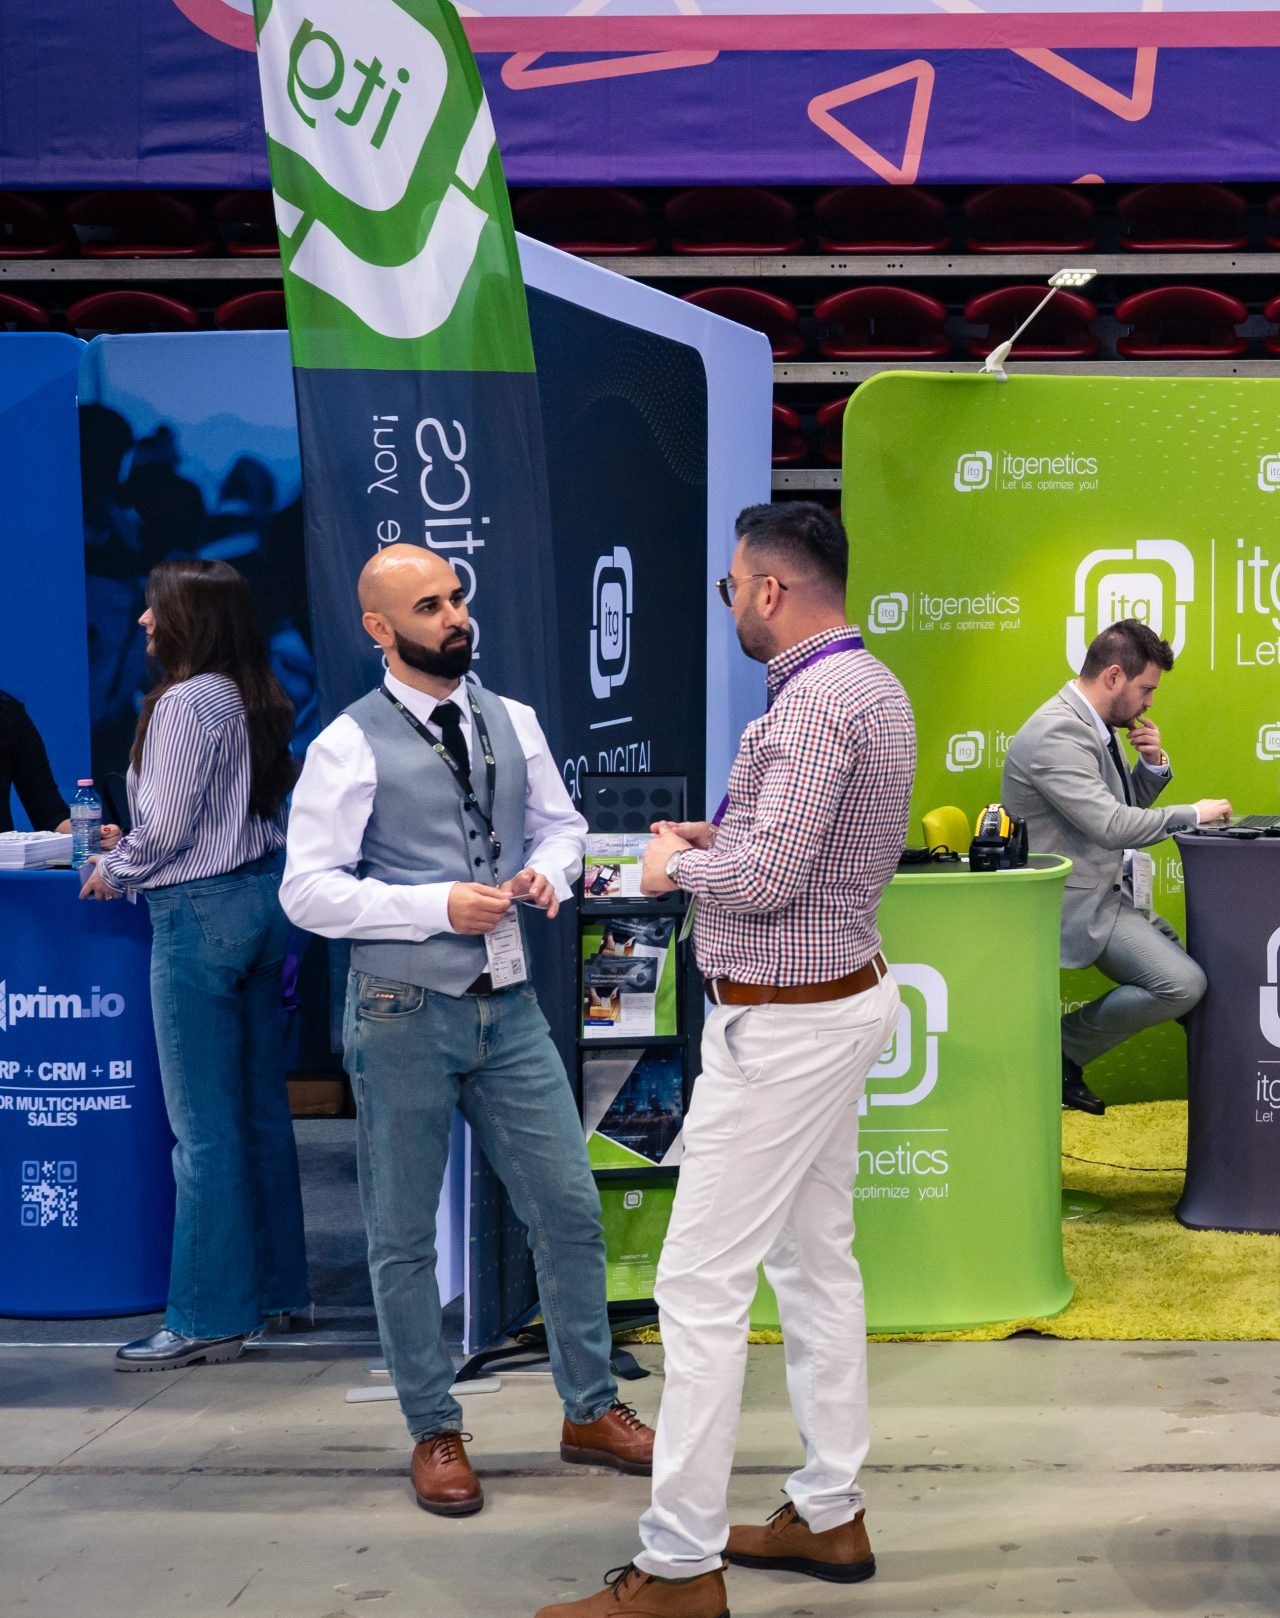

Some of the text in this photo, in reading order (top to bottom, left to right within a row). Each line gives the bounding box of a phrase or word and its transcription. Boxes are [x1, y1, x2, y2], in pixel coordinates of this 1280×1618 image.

[967, 466, 980, 478] itg
[1003, 451, 1098, 479] itgenetics
[1002, 480, 1017, 489] Let
[1037, 480, 1074, 491] optimize
[1079, 479, 1099, 491] you!
[881, 607, 895, 619] itg
[919, 591, 1020, 621] itgenetics
[604, 603, 619, 646] itg
[919, 618, 1020, 631] Let us optimize you!
[959, 746, 972, 759] itg
[9, 986, 125, 1026] prim.io
[38, 1062, 86, 1081] CRM
[109, 1060, 132, 1079] BI
[16, 1095, 132, 1111] MULTICHANEL
[28, 1112, 78, 1126] SALES
[1255, 1110, 1274, 1123] Let
[853, 1183, 949, 1201] optimize you!
